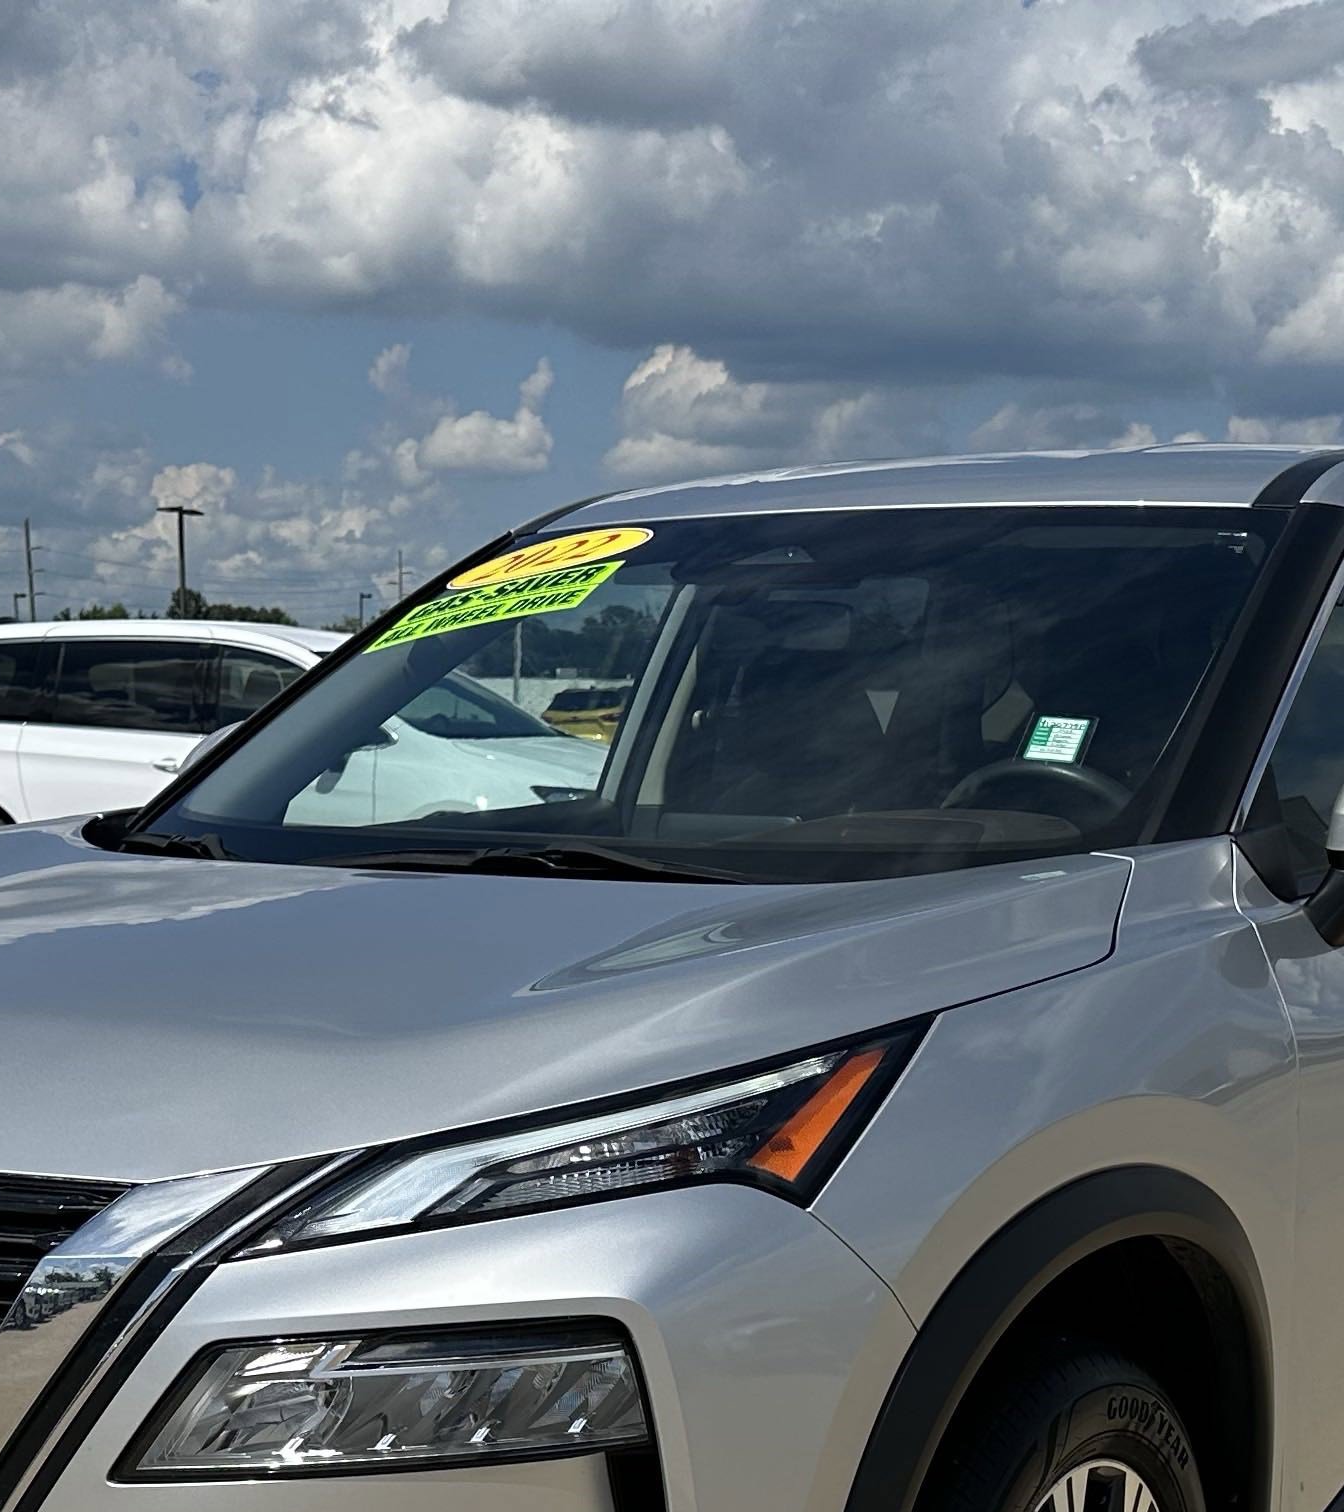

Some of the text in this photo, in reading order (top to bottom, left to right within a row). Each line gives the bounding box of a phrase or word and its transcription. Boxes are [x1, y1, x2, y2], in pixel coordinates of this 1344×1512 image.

[467, 533, 622, 583] 2022
[375, 588, 589, 647] ALL WHEEL DRIVE
[1106, 1396, 1189, 1470] GOODYEAR
